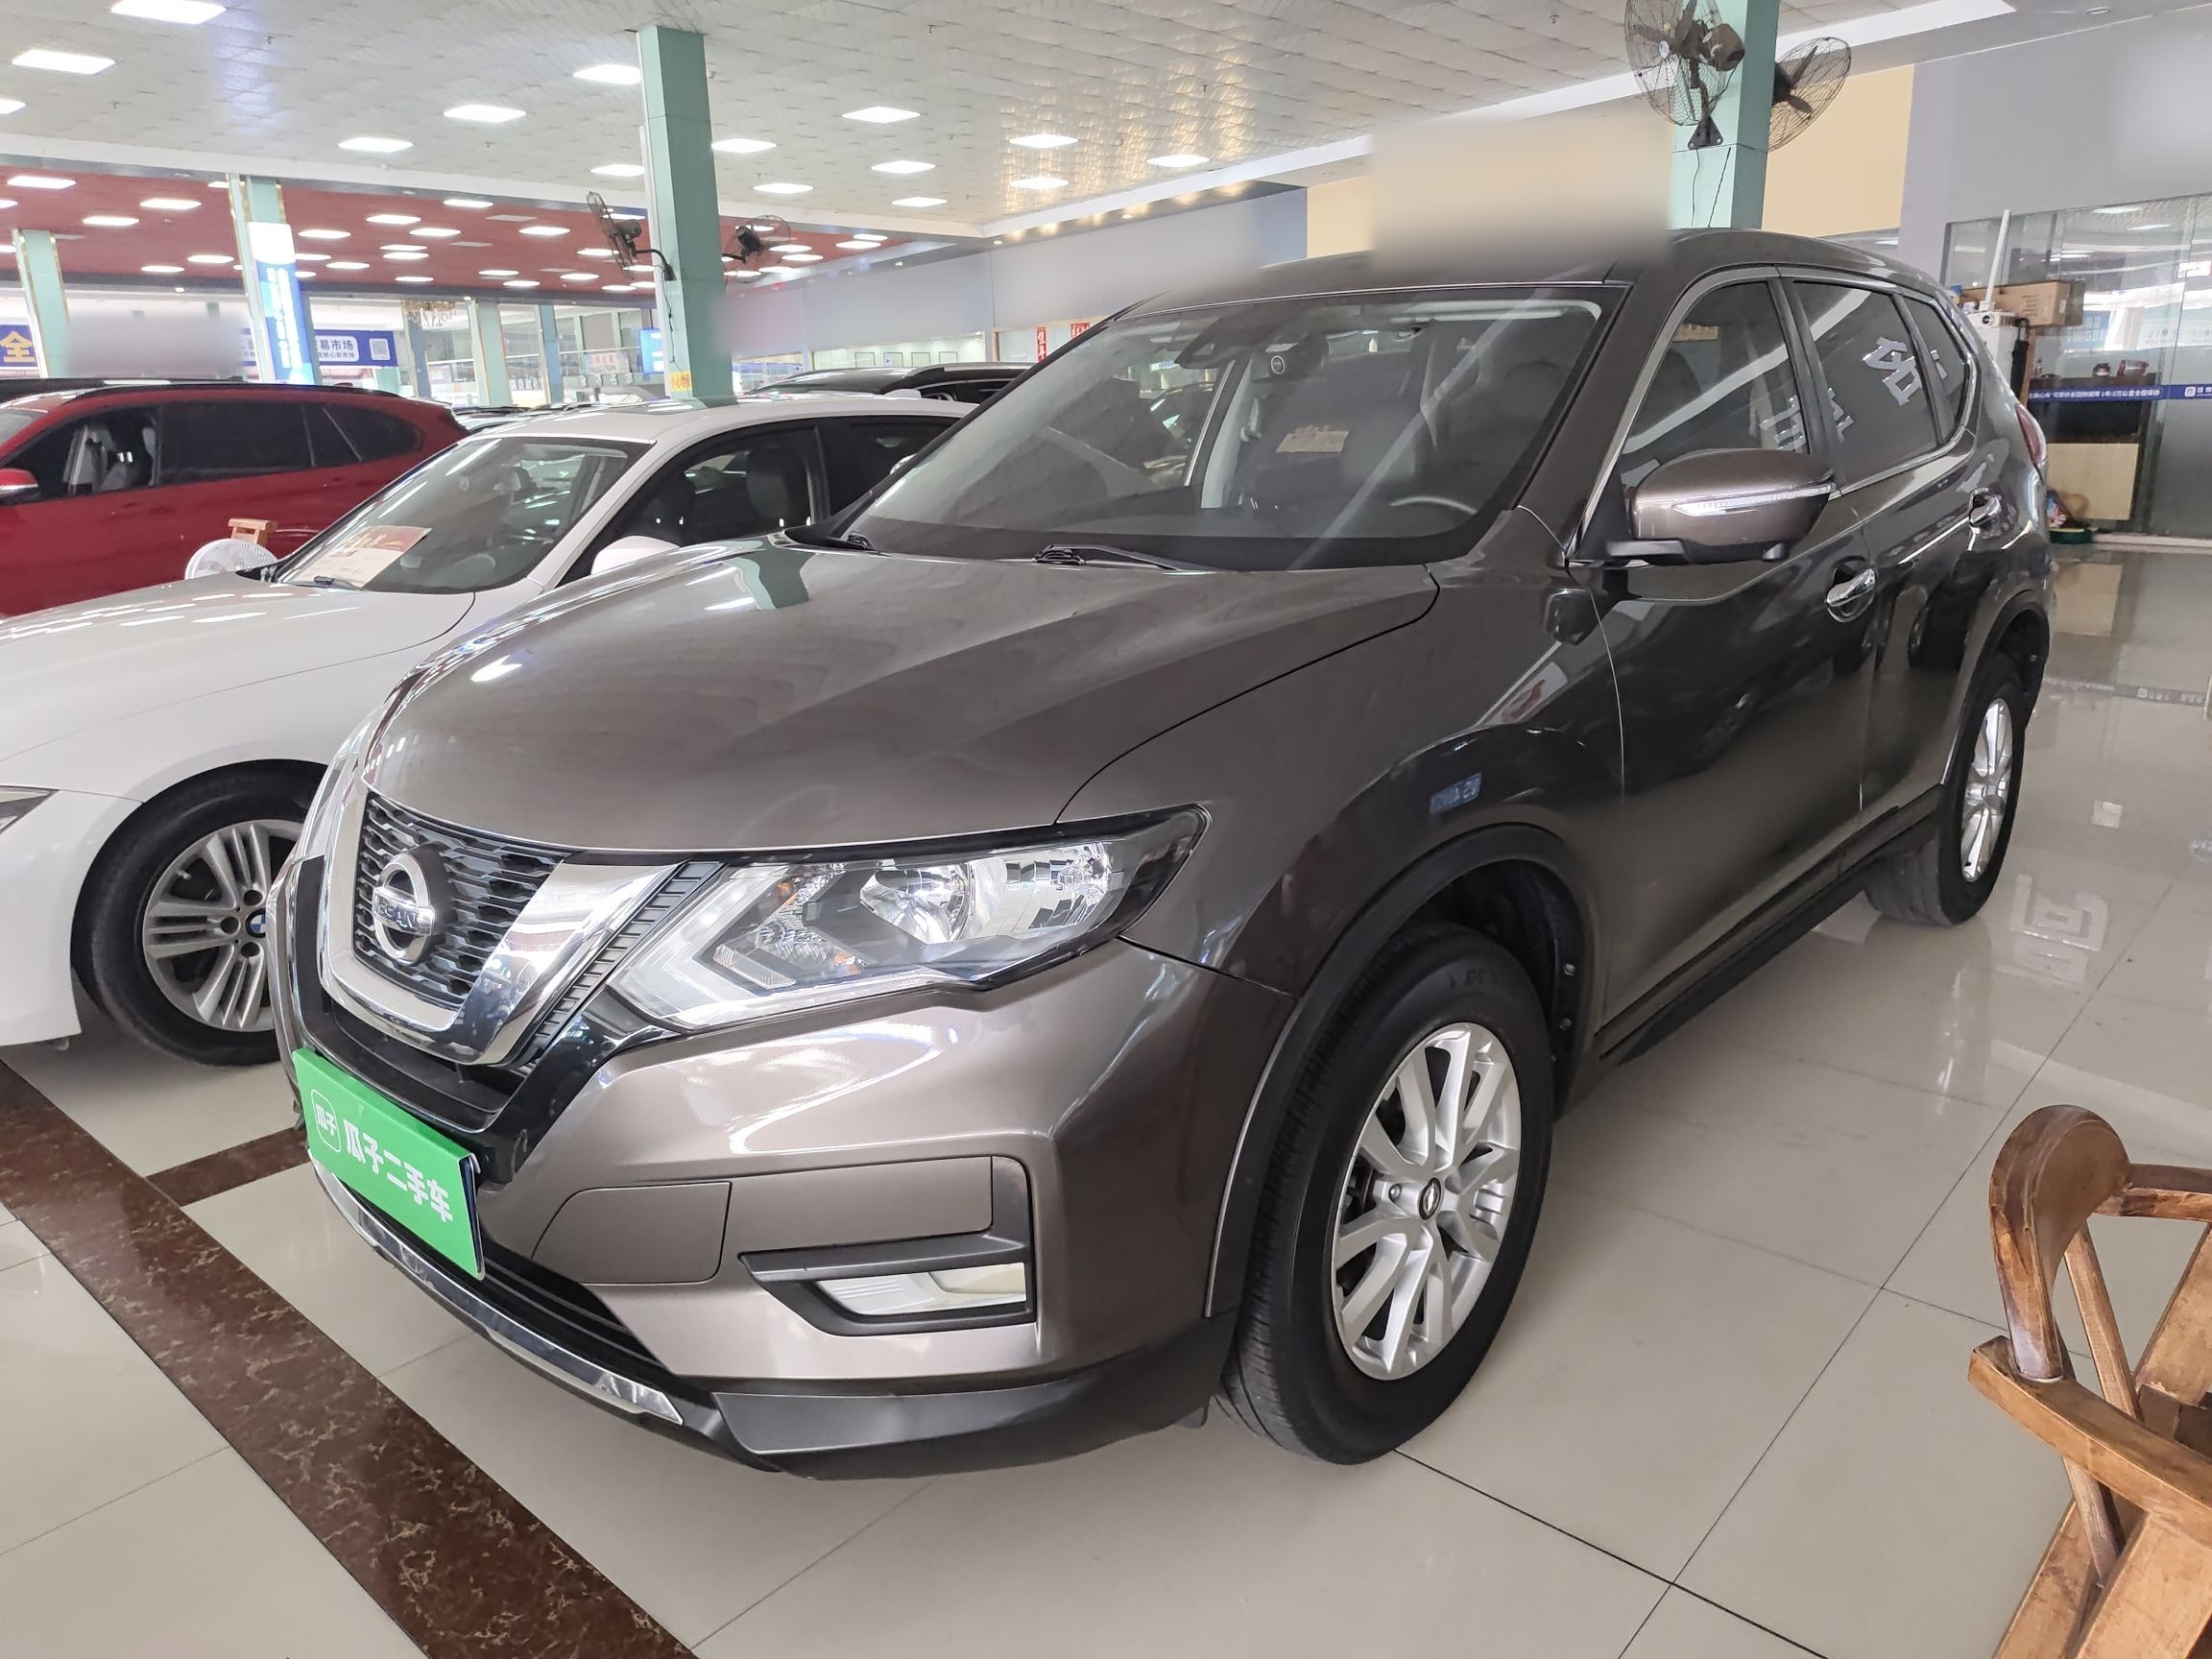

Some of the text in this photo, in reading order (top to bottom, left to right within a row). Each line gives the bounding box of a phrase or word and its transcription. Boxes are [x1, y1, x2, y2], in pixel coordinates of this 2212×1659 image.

[315, 1103, 337, 1137] 瓜子
[342, 1118, 453, 1223] 瓜子二手车
